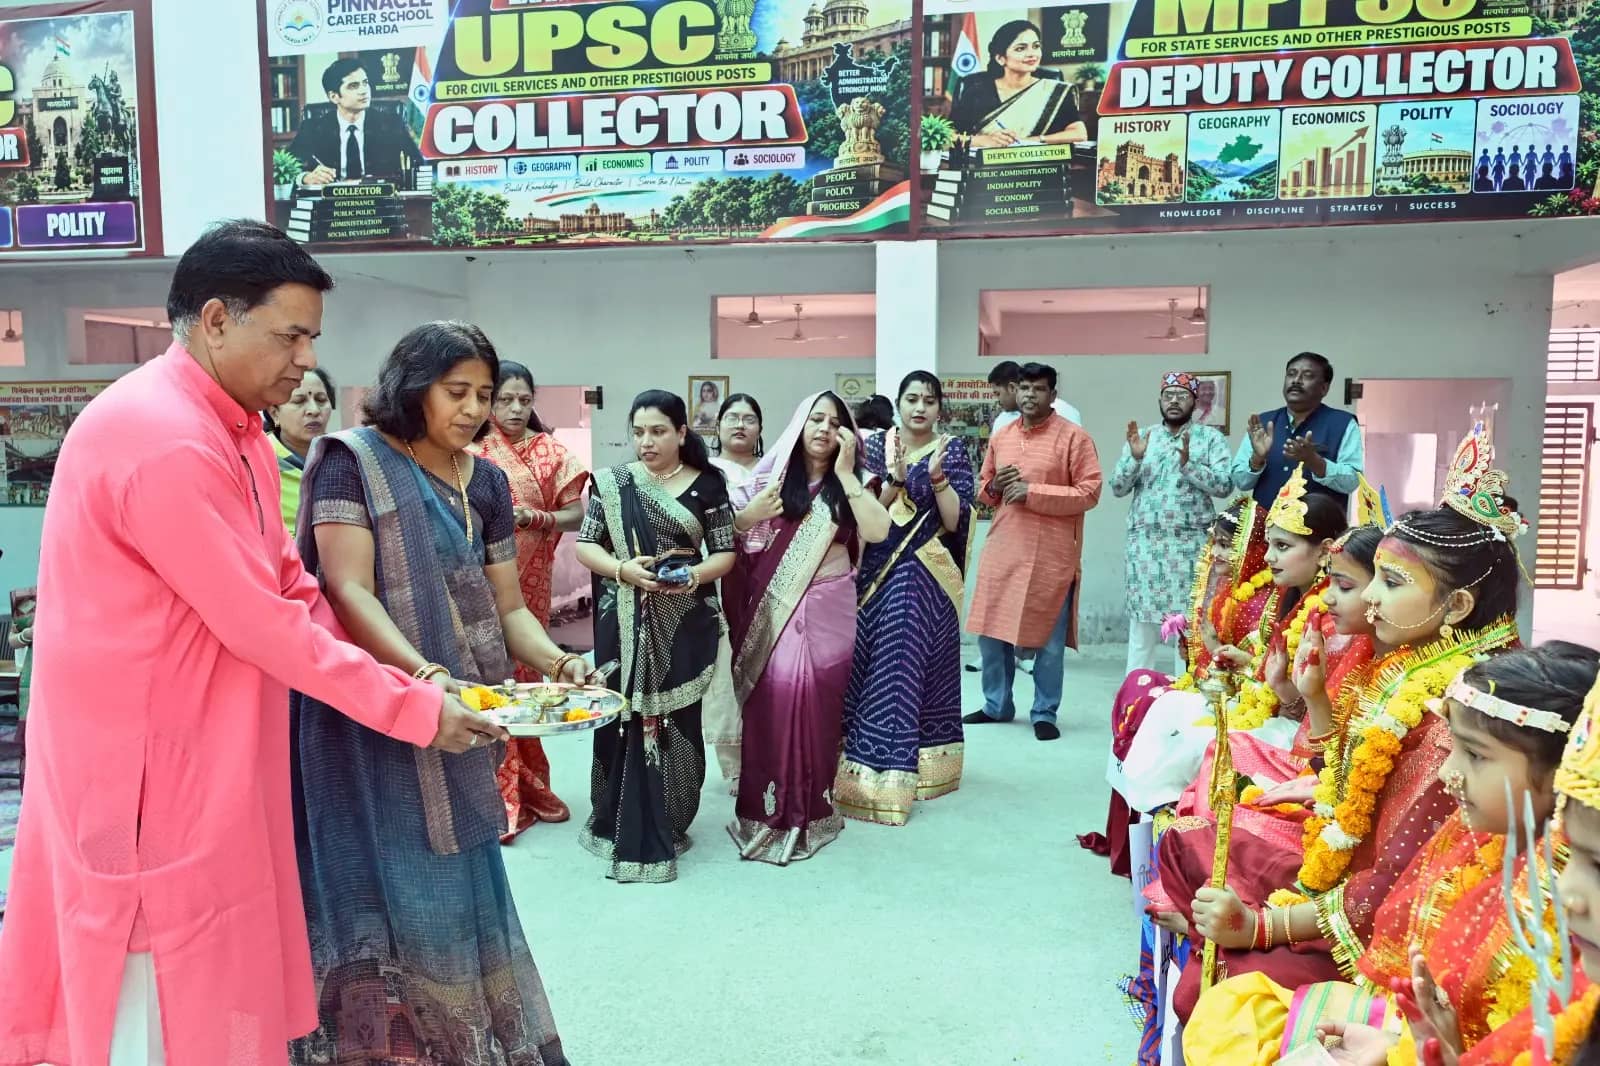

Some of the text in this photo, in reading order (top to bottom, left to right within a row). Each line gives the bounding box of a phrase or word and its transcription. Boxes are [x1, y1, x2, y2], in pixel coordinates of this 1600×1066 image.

[327, 13, 376, 26] CAREER
[380, 9, 433, 22] SCHOOL
[358, 24, 399, 36] HARDA
[454, 2, 715, 77] UPSC
[1142, 22, 1511, 53] FOR STATE SERVICES AND OTHER PRESTIGIOUS POSTS
[838, 69, 860, 77] BETTER
[1119, 45, 1558, 109] DEPUTY COLLECTOR
[446, 67, 756, 95] FOR CIVIL SERVICES AND OTHER PRESTIGIOUS POSTS
[838, 76, 887, 85] ADMINISTRATION
[838, 86, 869, 94] STRONGER
[1400, 106, 1453, 121] POLITY
[1490, 102, 1564, 117] SOCIOLOGY
[433, 90, 789, 155] COLLECTOR
[1199, 115, 1271, 130] GEOGRAPHY
[1292, 110, 1365, 126] ECONOMICS
[1114, 119, 1171, 134] HISTORY
[753, 153, 795, 164] SOCIOLOGY
[987, 149, 1065, 160] DEPUTY COLLECTOR
[603, 159, 644, 169] ECONOMICS
[684, 156, 709, 166] POLITY
[465, 165, 498, 175] HISTORY
[531, 162, 571, 172] GEOGRAPHY
[974, 167, 1057, 178] PUBLIC ADMINISTRATION
[825, 171, 856, 183] PEOPLE
[332, 187, 382, 196] COLLECTOR
[825, 186, 854, 197] POLICY
[995, 193, 1033, 202] ECONOMY
[819, 201, 860, 211] PROGRESS
[985, 205, 1040, 216] SOCIAL ISSUES
[1247, 206, 1304, 215] DISCIPLINE
[1330, 204, 1384, 213] STRATEGY
[1409, 201, 1457, 210] SUCCESS
[1160, 208, 1222, 218] KNOWLEDGE
[47, 211, 105, 237] POLITY
[330, 218, 382, 227] ADMINISTRATION
[349, 228, 390, 237] DEVELOPMENT
